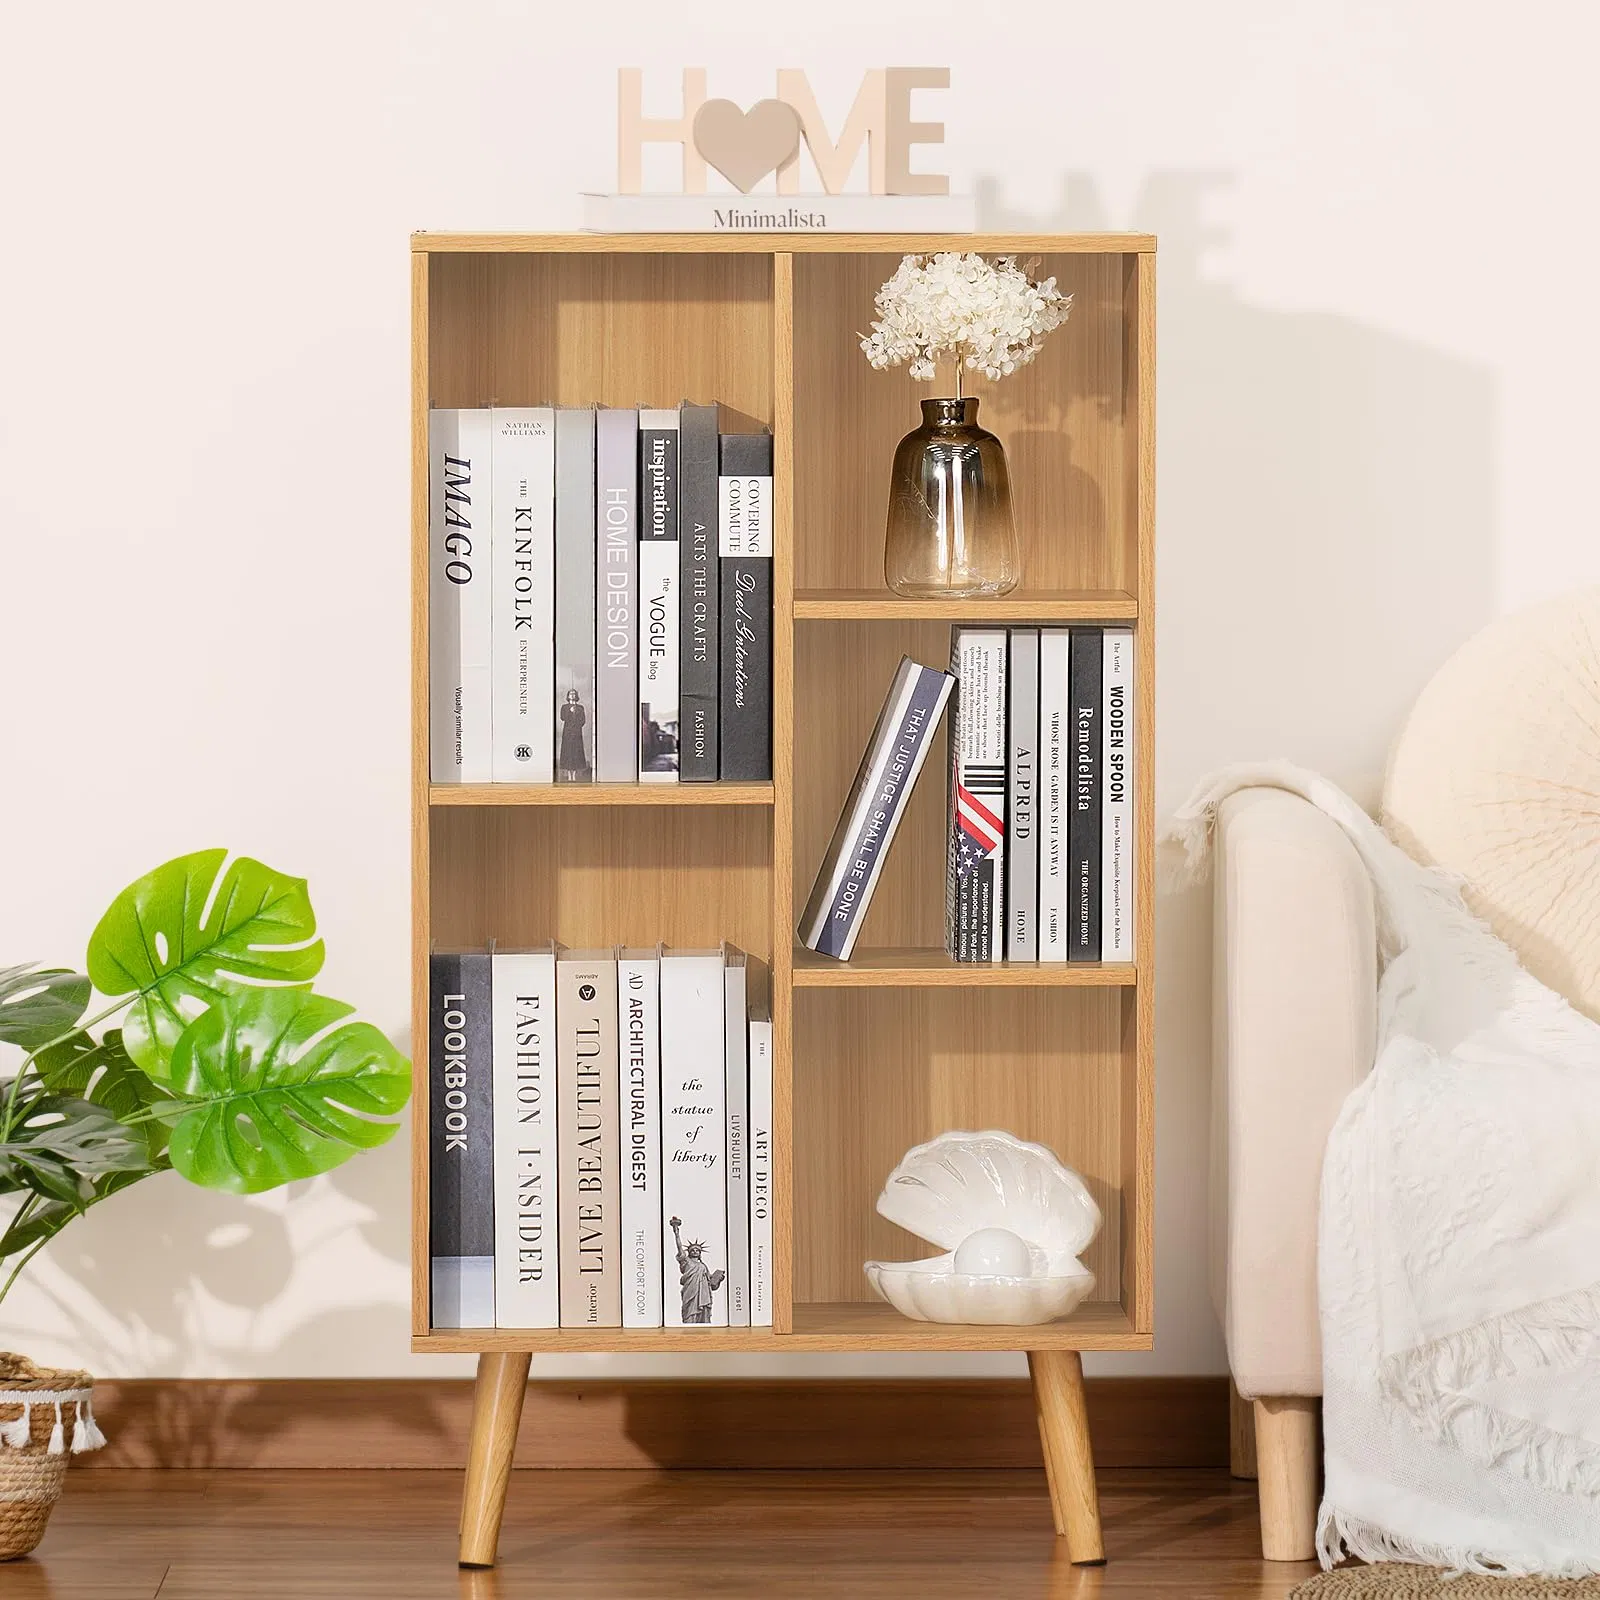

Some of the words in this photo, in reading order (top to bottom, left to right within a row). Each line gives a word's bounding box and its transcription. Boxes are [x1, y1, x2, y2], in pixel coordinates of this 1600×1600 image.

[713, 208, 826, 229] Minimalista
[647, 439, 671, 536] inspiration
[444, 453, 472, 584] IMAGO
[606, 488, 628, 563] HOME
[729, 480, 740, 551] COMMUTE
[749, 480, 760, 553] COVERING
[694, 523, 705, 561] ARTS
[514, 507, 532, 630] KINFOLK
[694, 568, 705, 596] THE
[606, 570, 629, 668] DESION
[734, 570, 756, 626] Duel
[650, 596, 665, 657] VOGUE
[694, 602, 706, 662] CRAFTS
[519, 640, 527, 715] ENTERPRENEUR
[648, 661, 657, 680] blog
[454, 686, 464, 714] Visually
[962, 714, 966, 722] on
[1110, 686, 1124, 748] WOODEN
[456, 716, 464, 740] similar
[696, 711, 704, 758] FASHION
[901, 706, 926, 744] THAT
[456, 740, 464, 765] results
[1078, 707, 1093, 811] Remodelista
[880, 744, 910, 804] JUSTICE
[1016, 747, 1031, 840] ALPRED
[1050, 775, 1058, 813] GARDEN
[1110, 753, 1124, 803] SPOON
[858, 810, 886, 856] SHALL
[1050, 814, 1058, 824] IS
[1050, 826, 1058, 835] IT
[850, 859, 867, 879] BE
[1050, 838, 1058, 877] ANYWAY
[1080, 860, 1088, 875] THE
[835, 881, 859, 922] DONE
[1080, 876, 1088, 921] ORGANIZED
[982, 925, 988, 934] be
[1017, 910, 1025, 944] HOME
[1080, 922, 1088, 945] HOME
[629, 971, 643, 990] AD
[443, 994, 467, 1152] LOOKBOOK
[516, 995, 541, 1125] FASHION
[628, 998, 646, 1130] ARCHITECTURAL
[681, 1078, 703, 1091] the
[576, 1019, 603, 1194] BEAUTIFUL
[671, 1105, 713, 1115] statue
[686, 1127, 703, 1143] of
[731, 1114, 741, 1180] LIVSHJULET
[755, 1128, 767, 1165] ART
[631, 1135, 646, 1192] DIGEST
[671, 1151, 717, 1168] liberty
[756, 1171, 768, 1219] DECO
[580, 1204, 603, 1275] LIVE
[636, 1230, 644, 1243] THE
[636, 1245, 644, 1288] COMFORT
[587, 1283, 597, 1323] Interior
[636, 1291, 644, 1316] ZOOM
